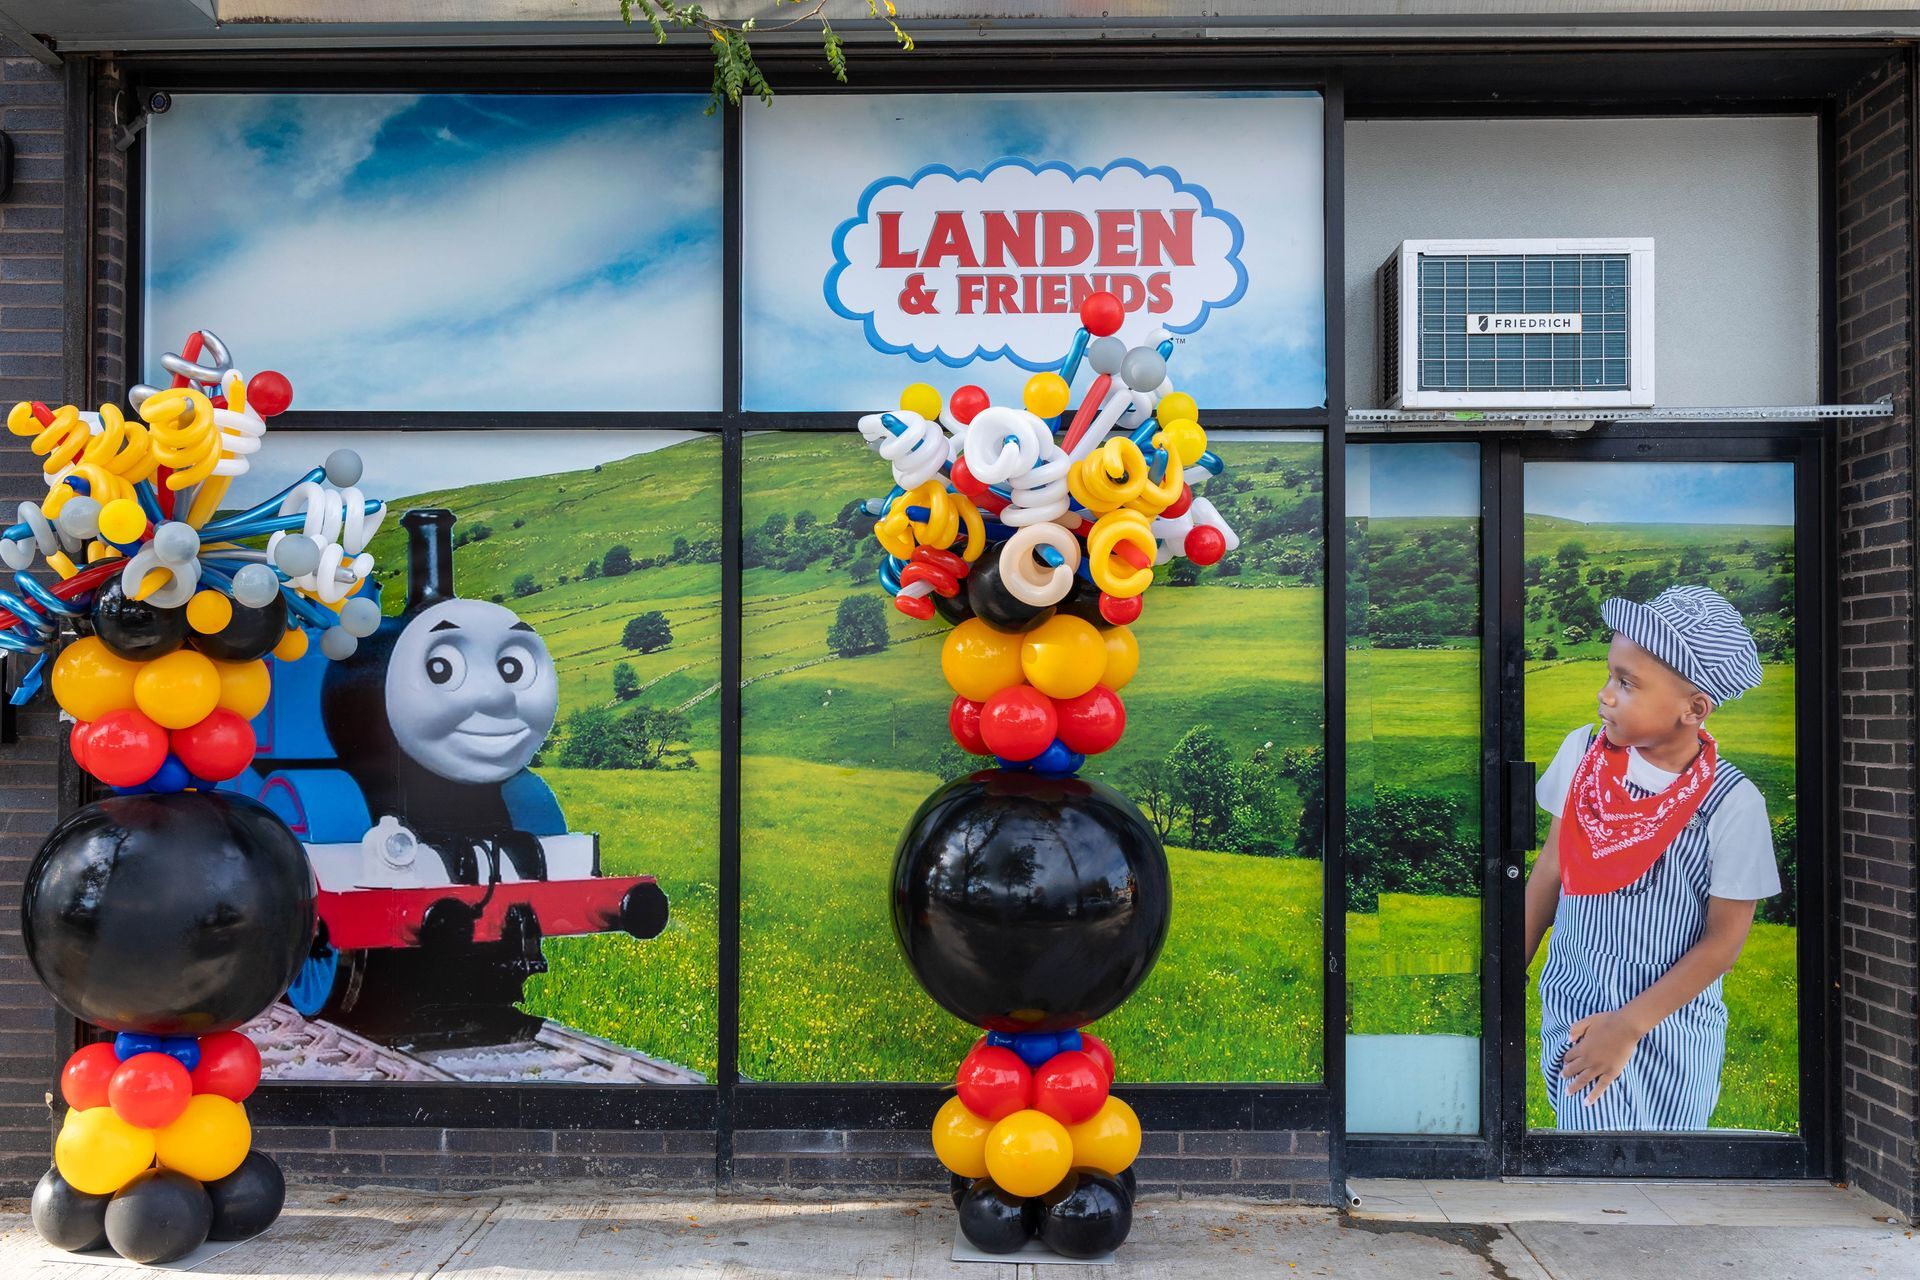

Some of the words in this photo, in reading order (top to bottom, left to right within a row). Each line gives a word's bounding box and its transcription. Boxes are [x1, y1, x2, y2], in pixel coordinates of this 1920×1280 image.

[876, 208, 1198, 269] LANDEN
[897, 272, 941, 316] &
[955, 271, 1174, 315] FRIENDS
[1495, 318, 1571, 328] FRIEDRICH
